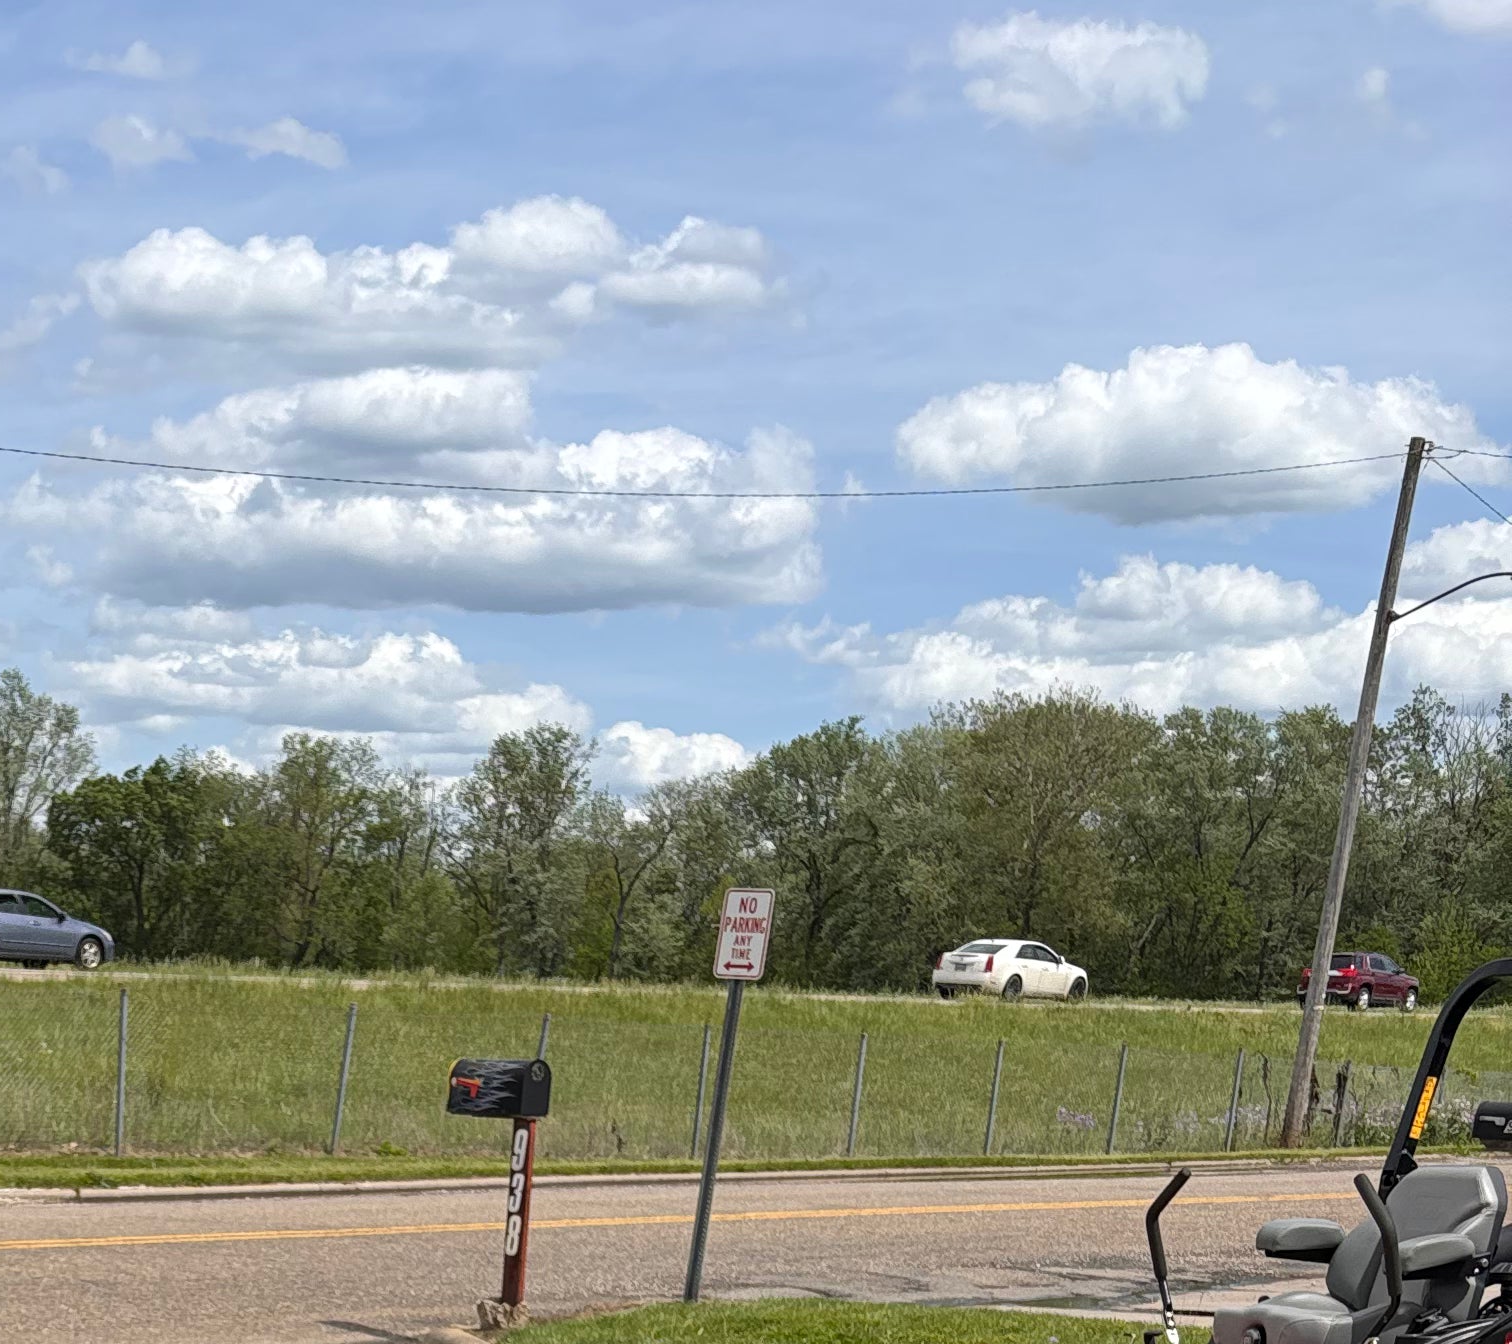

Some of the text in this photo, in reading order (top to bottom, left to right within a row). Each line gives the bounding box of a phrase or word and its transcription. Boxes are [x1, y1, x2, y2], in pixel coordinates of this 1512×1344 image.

[738, 897, 758, 914] NO
[723, 916, 767, 934] PARKING
[732, 935, 753, 947] ANY
[731, 948, 752, 960] TIME
[505, 1128, 529, 1256] 938
